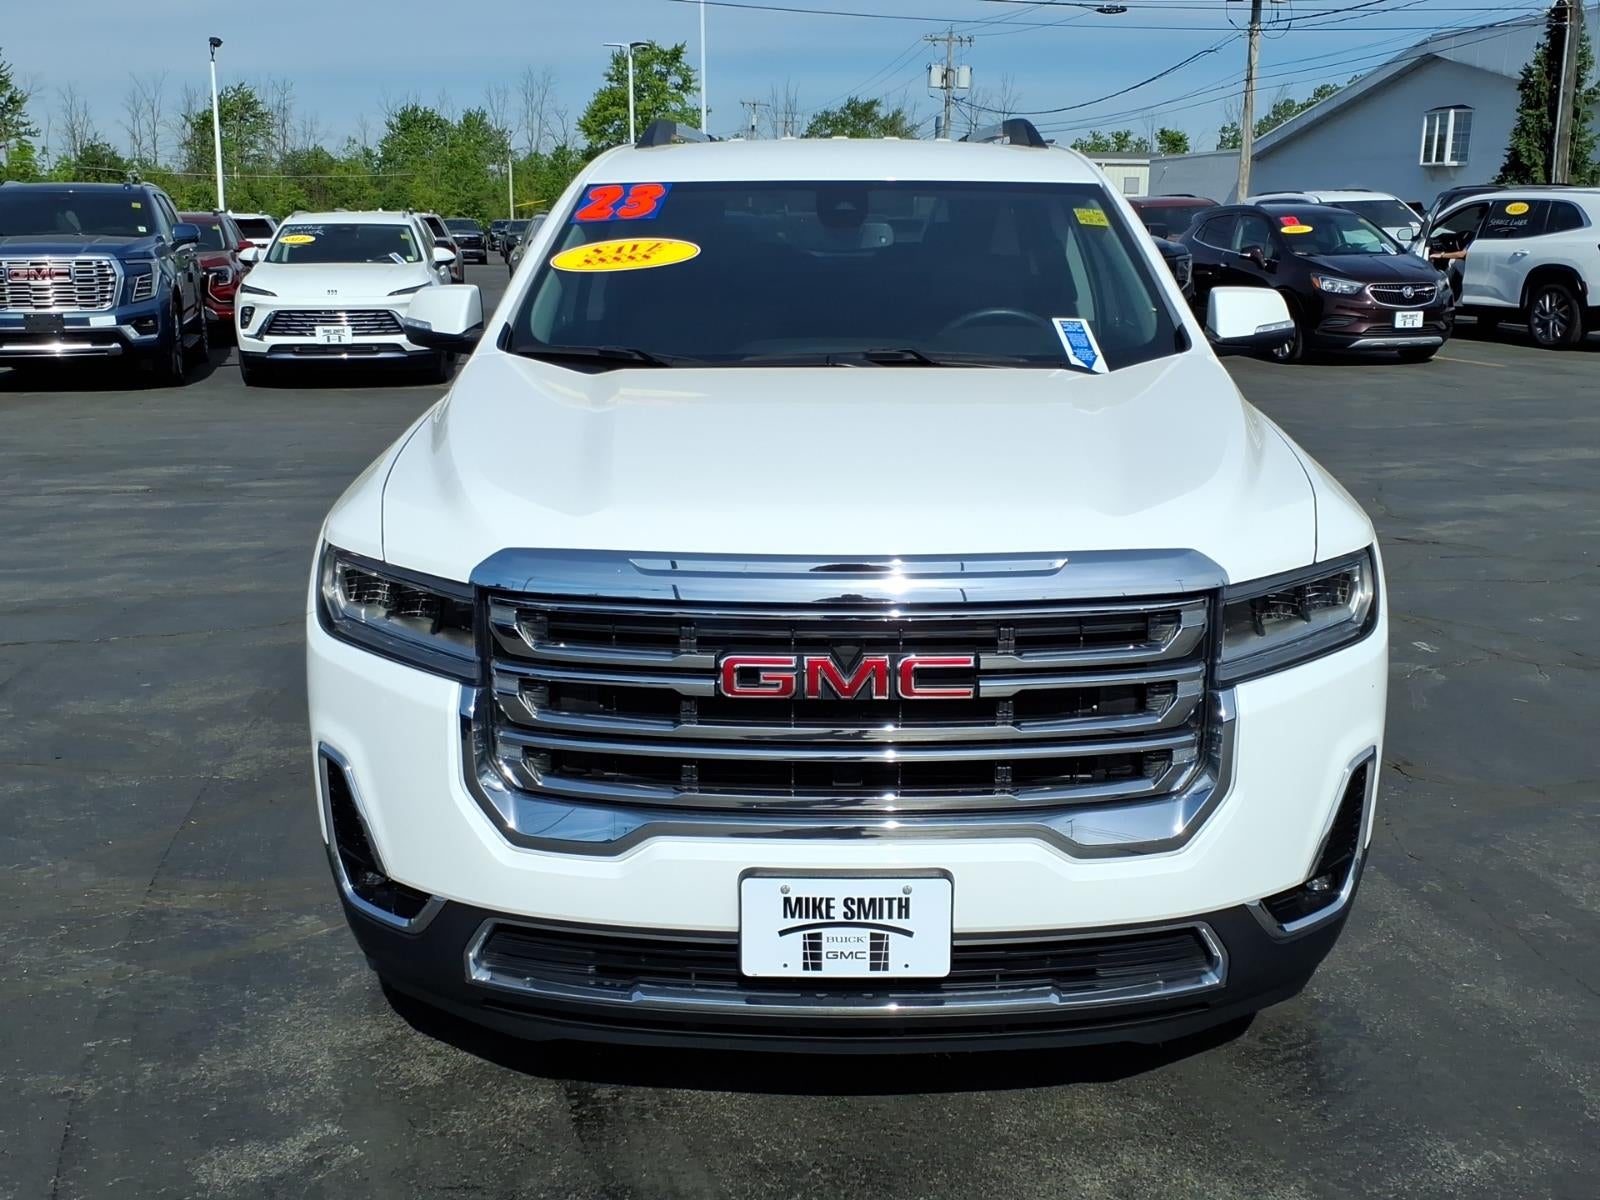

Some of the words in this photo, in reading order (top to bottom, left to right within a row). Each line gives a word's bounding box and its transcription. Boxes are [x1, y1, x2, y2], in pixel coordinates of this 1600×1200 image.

[575, 184, 666, 221] 23
[9, 268, 70, 281] GMC
[720, 655, 975, 700] GMC
[782, 896, 836, 920] MIKE
[842, 896, 911, 920] SMITH
[825, 951, 867, 960] GMC
